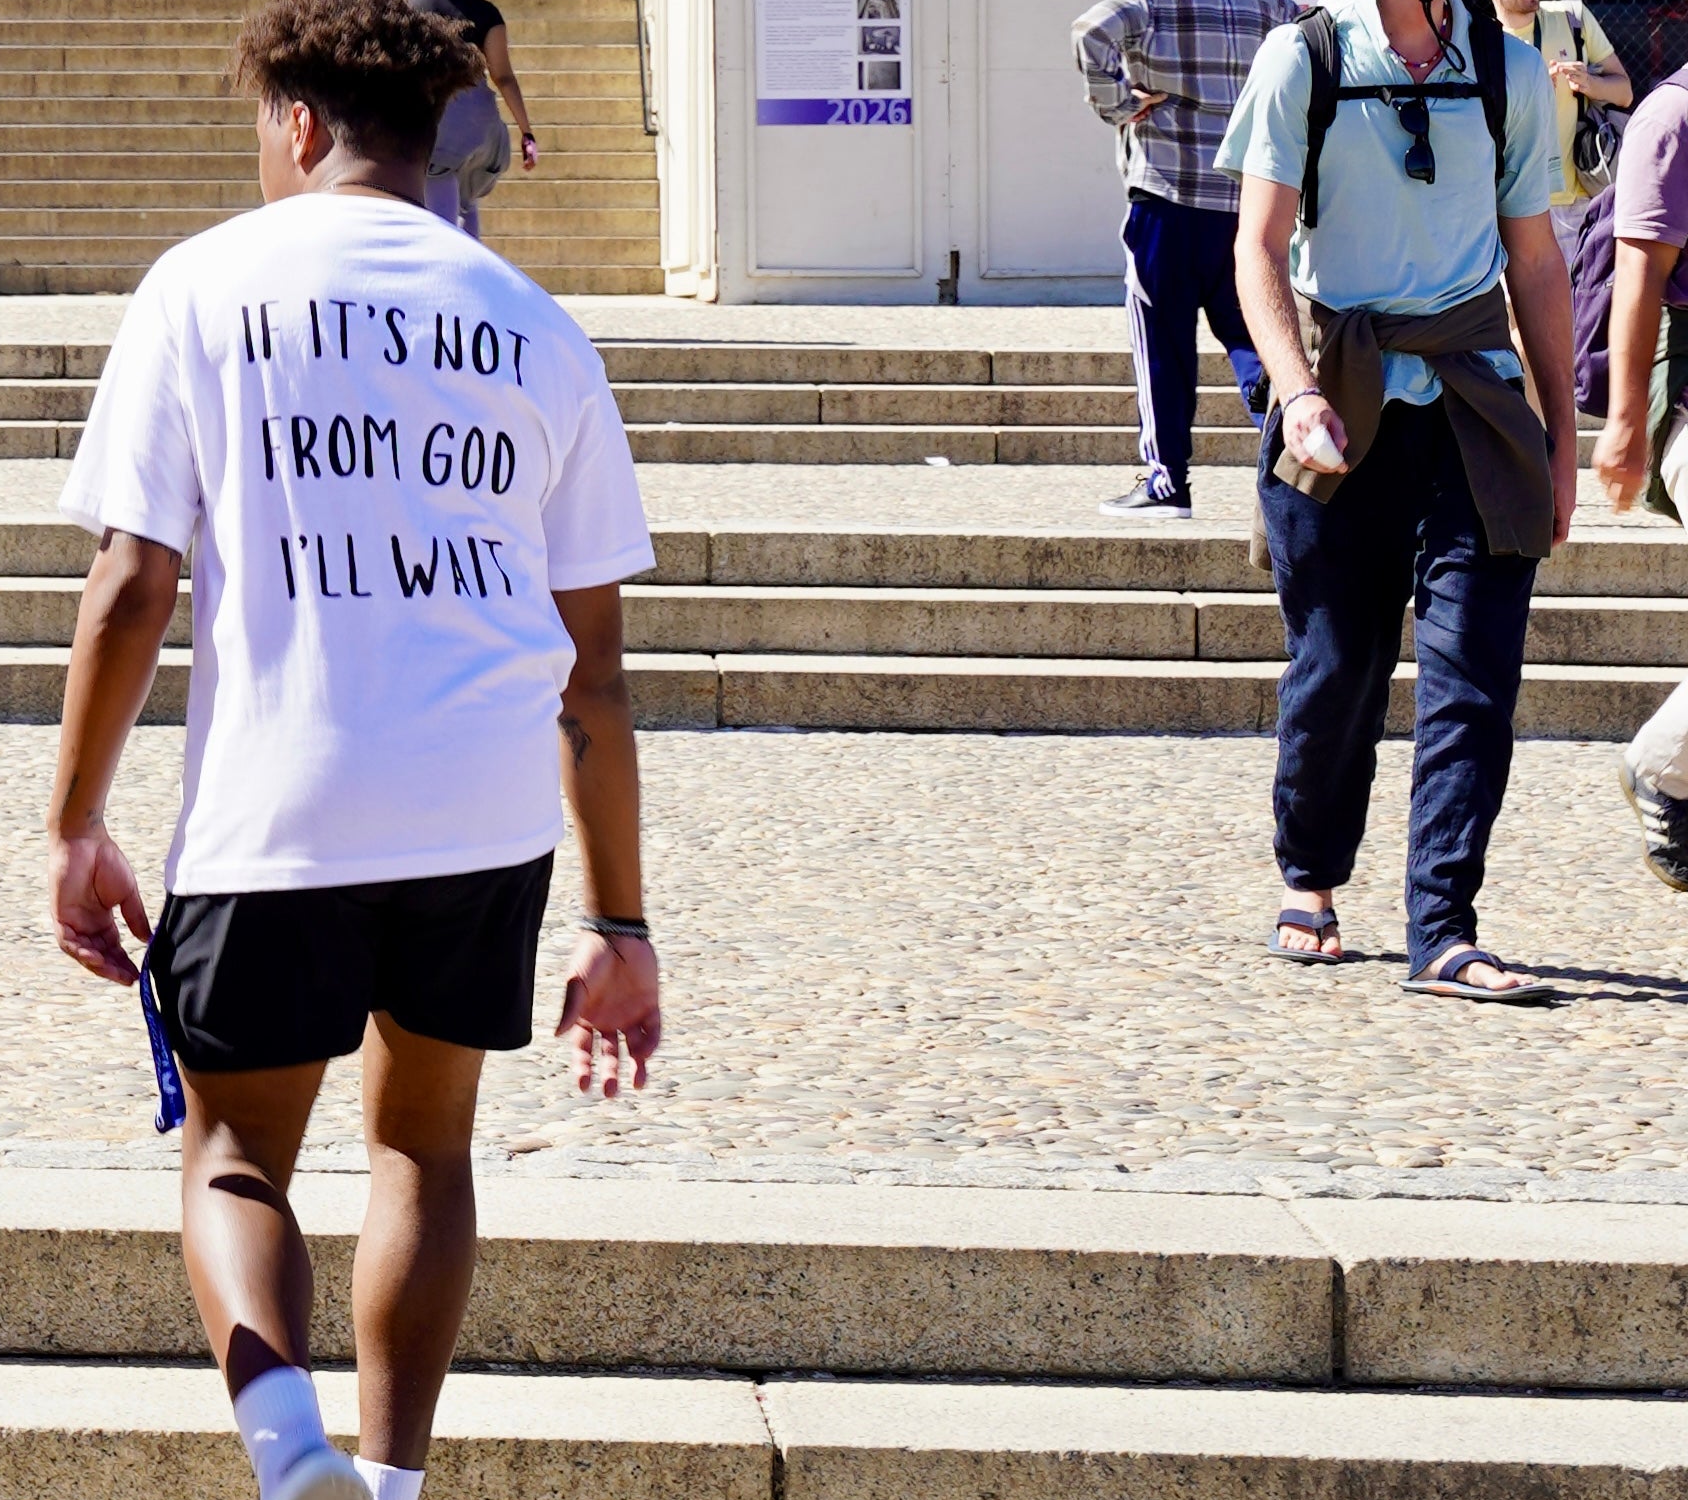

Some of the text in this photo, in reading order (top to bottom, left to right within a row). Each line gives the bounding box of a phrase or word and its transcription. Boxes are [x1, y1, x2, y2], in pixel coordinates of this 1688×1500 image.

[827, 99, 907, 124] 2026
[242, 299, 530, 387] IF IT'S NOT
[262, 414, 514, 495] FROM GOD
[280, 533, 513, 600] I'LL WAIT
